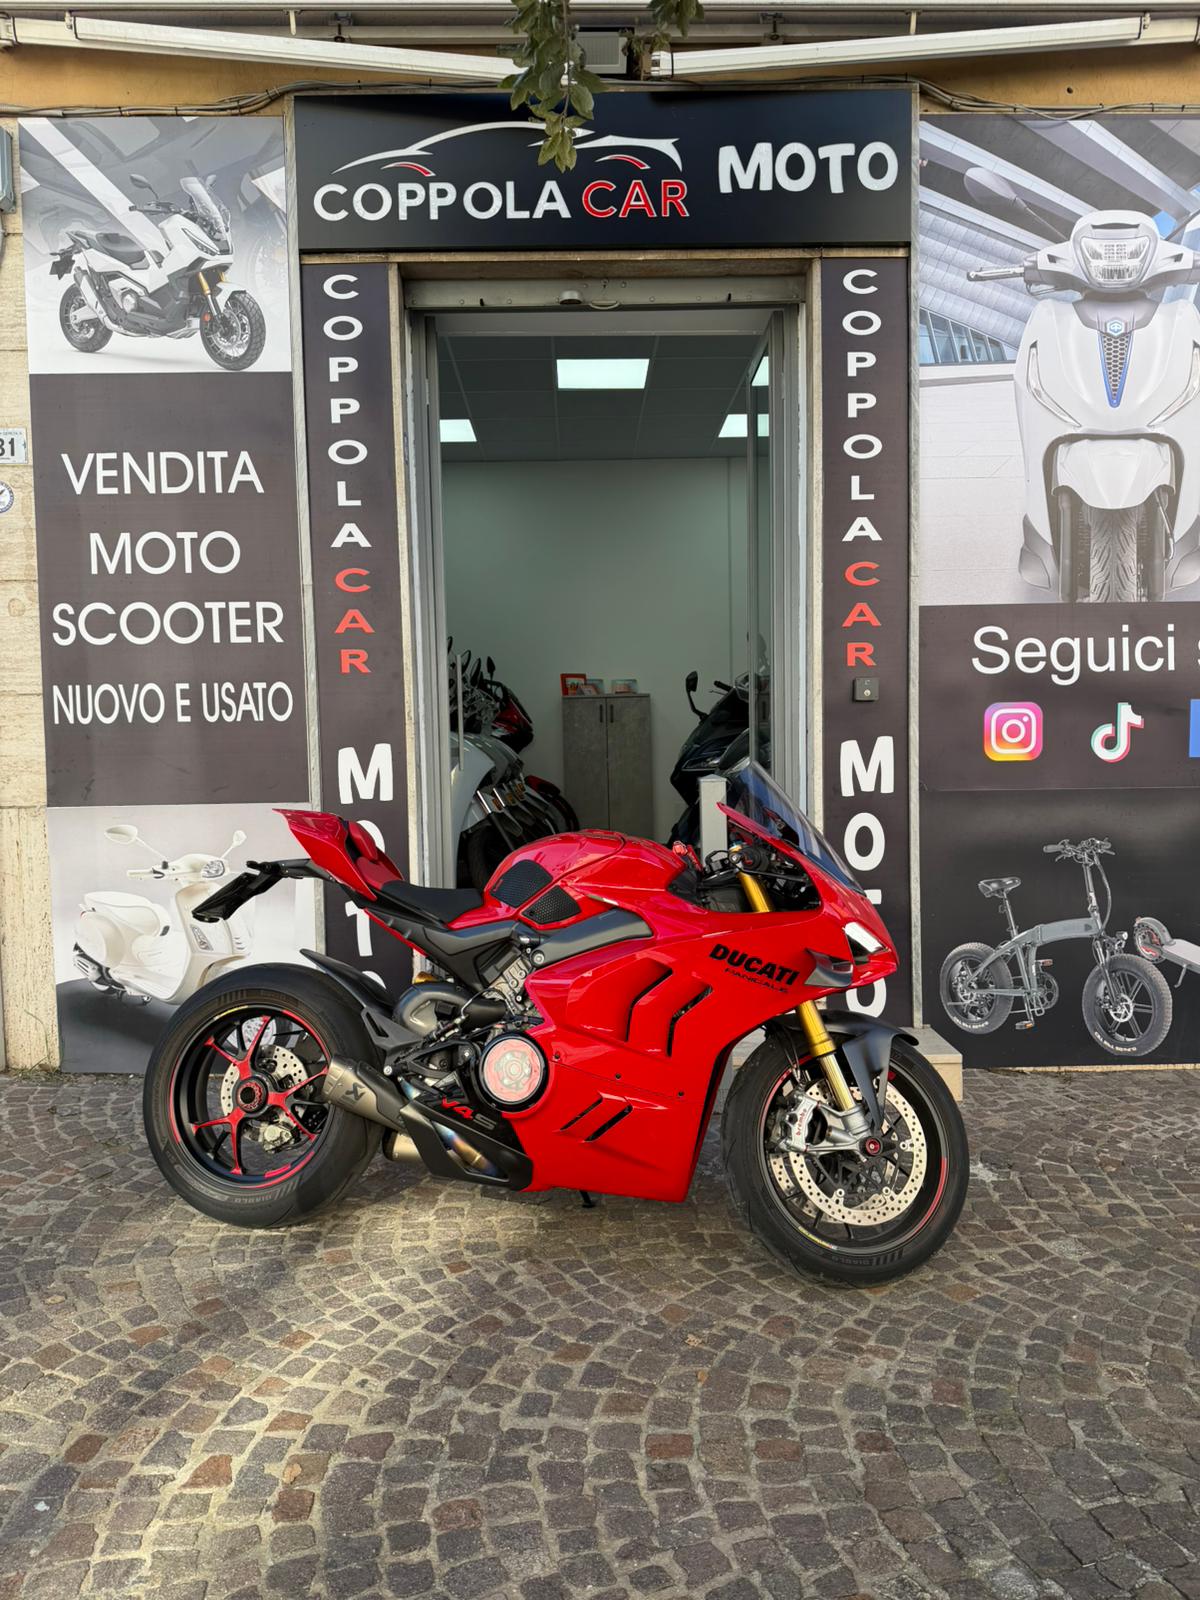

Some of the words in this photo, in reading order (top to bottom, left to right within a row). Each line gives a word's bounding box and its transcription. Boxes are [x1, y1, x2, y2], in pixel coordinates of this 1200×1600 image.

[313, 180, 572, 222] COPPOLA
[581, 179, 690, 219] CAR
[718, 141, 899, 194] MOTO
[322, 273, 372, 548] COPPOLA
[841, 268, 883, 542] COPPOLA
[61, 450, 265, 495] VENDITA
[89, 530, 241, 575] MOTO
[52, 601, 284, 646] SCOOTER
[334, 567, 375, 674] CAR
[841, 561, 882, 667] CAR
[971, 623, 1175, 686] Seguici
[52, 683, 165, 725] NUOVO
[176, 682, 191, 722] E
[201, 681, 293, 722] USATO
[840, 735, 895, 1018] MOO
[709, 943, 800, 986] DUCATI
